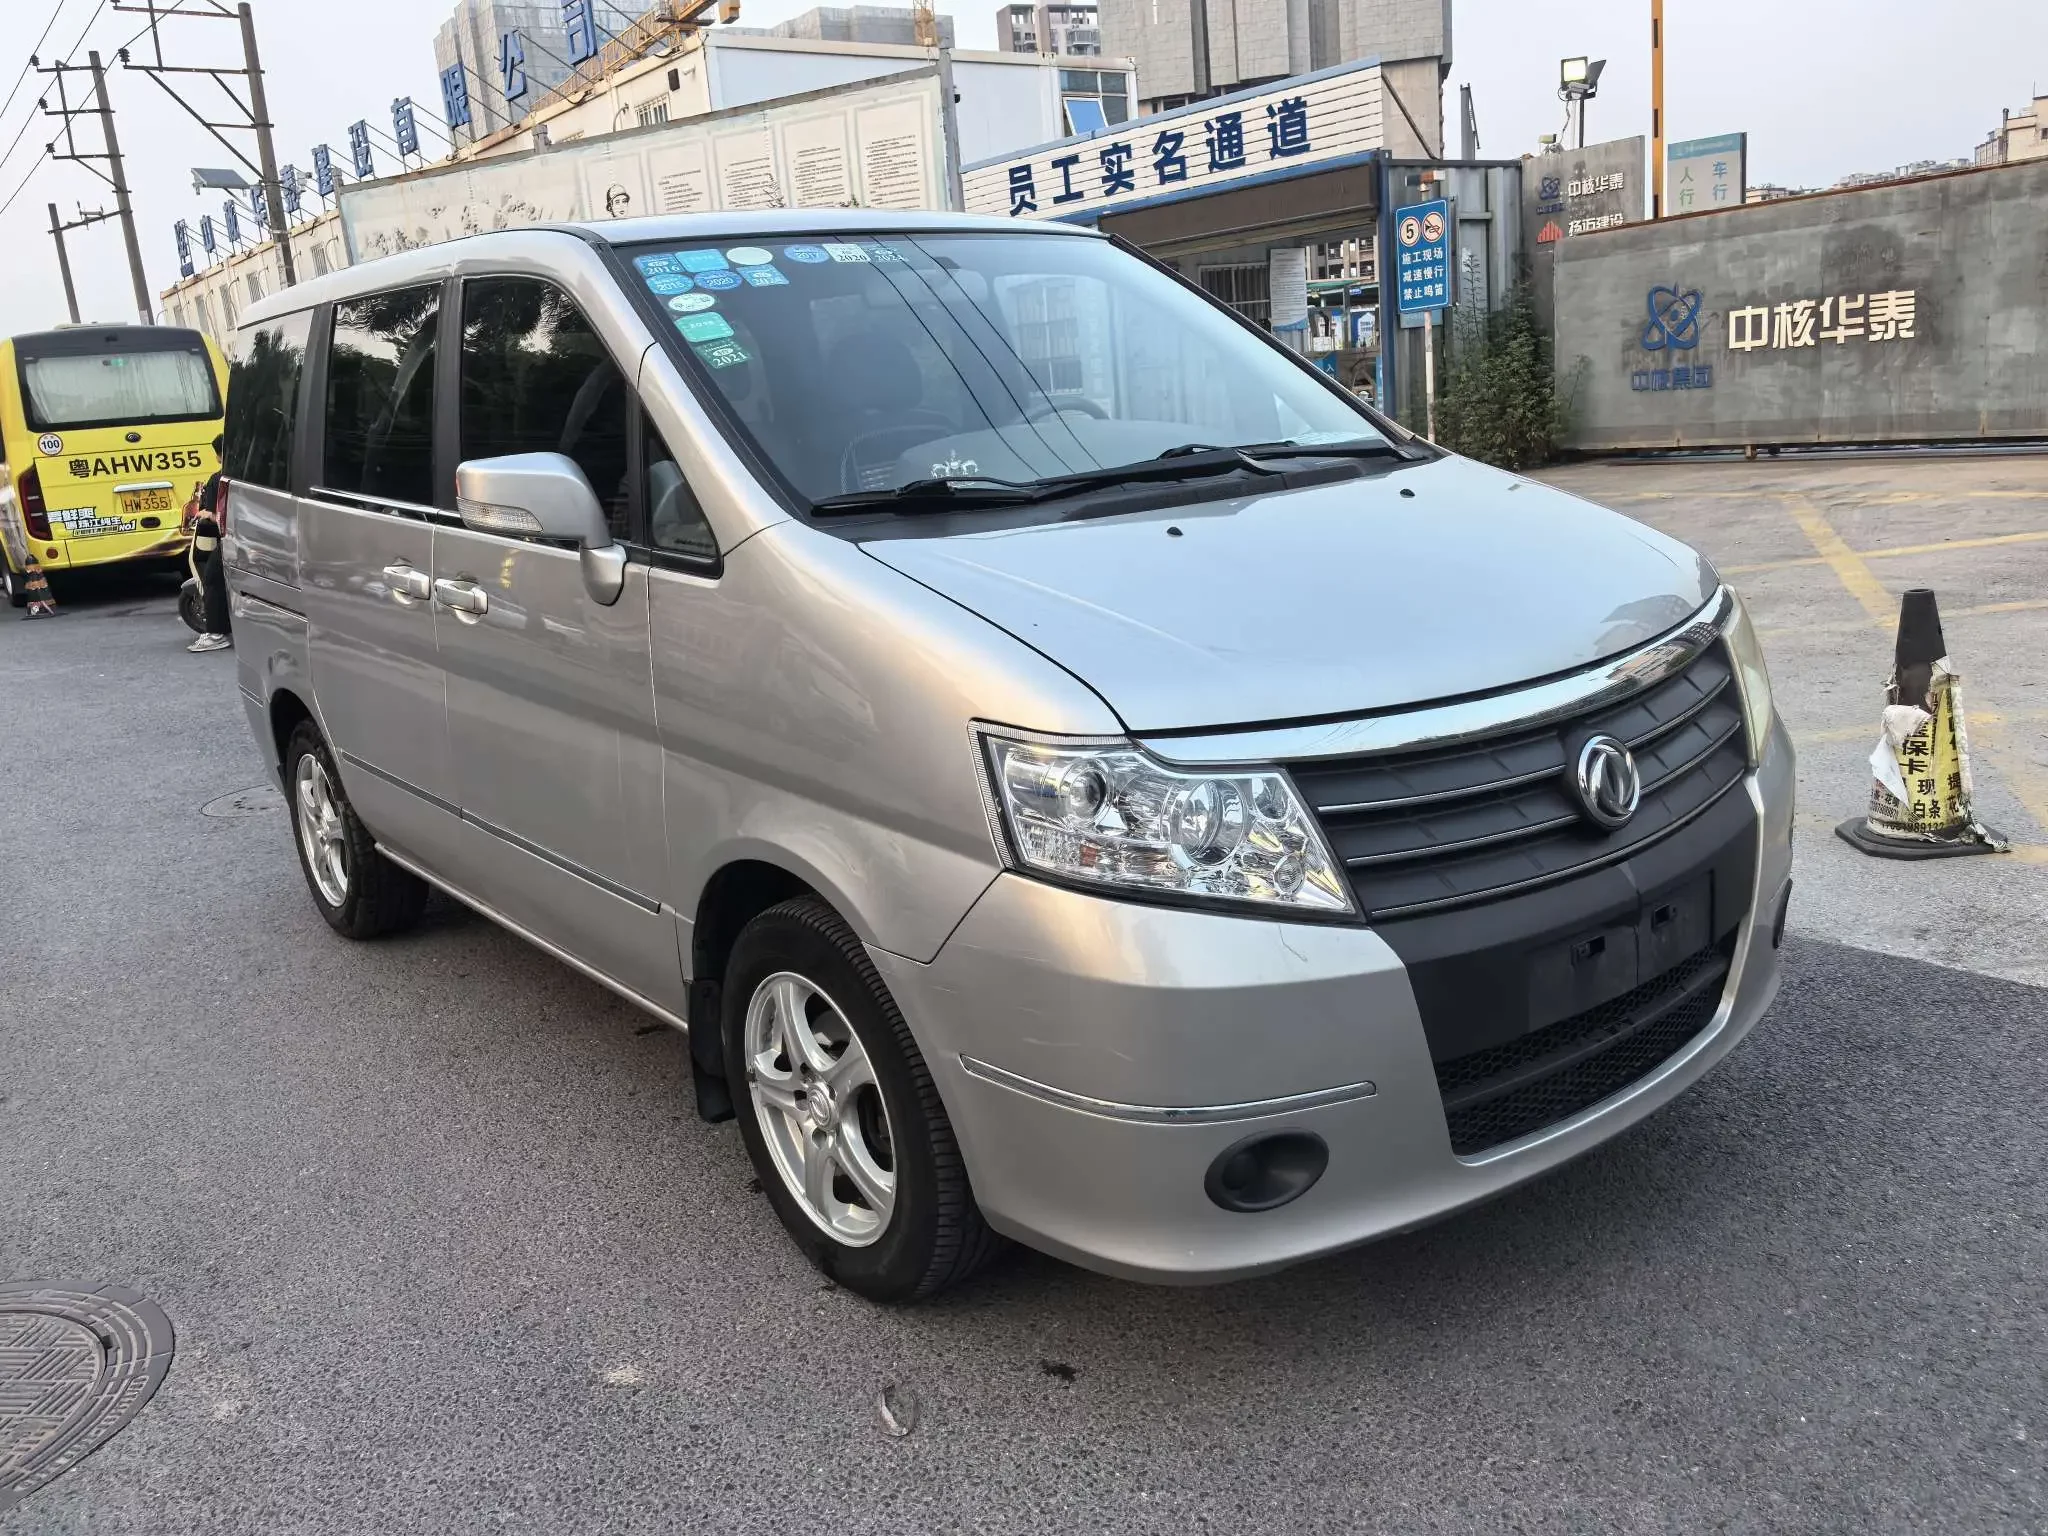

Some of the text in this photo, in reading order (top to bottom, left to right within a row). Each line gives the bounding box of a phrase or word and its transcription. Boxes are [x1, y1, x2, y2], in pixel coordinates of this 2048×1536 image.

[1009, 96, 1311, 217] 员工实名通道
[1568, 172, 1624, 197] 中核华泰
[1679, 166, 1695, 212] 人行
[1406, 223, 1414, 239] 5
[1402, 247, 1443, 264] 施工现场
[646, 264, 681, 275] 2016
[1403, 265, 1444, 282] 减速慢行
[656, 281, 685, 290] 2015
[706, 277, 734, 286] 2020
[1403, 284, 1444, 300] 禁止鸣笛
[1728, 289, 1915, 351] 中核华泰
[712, 353, 747, 367] 2021
[1631, 364, 1713, 391] 中核集团
[41, 439, 60, 450] 100
[69, 450, 202, 478] 粤AHW355
[124, 496, 169, 513] HW355
[1914, 800, 1941, 819] 白条
